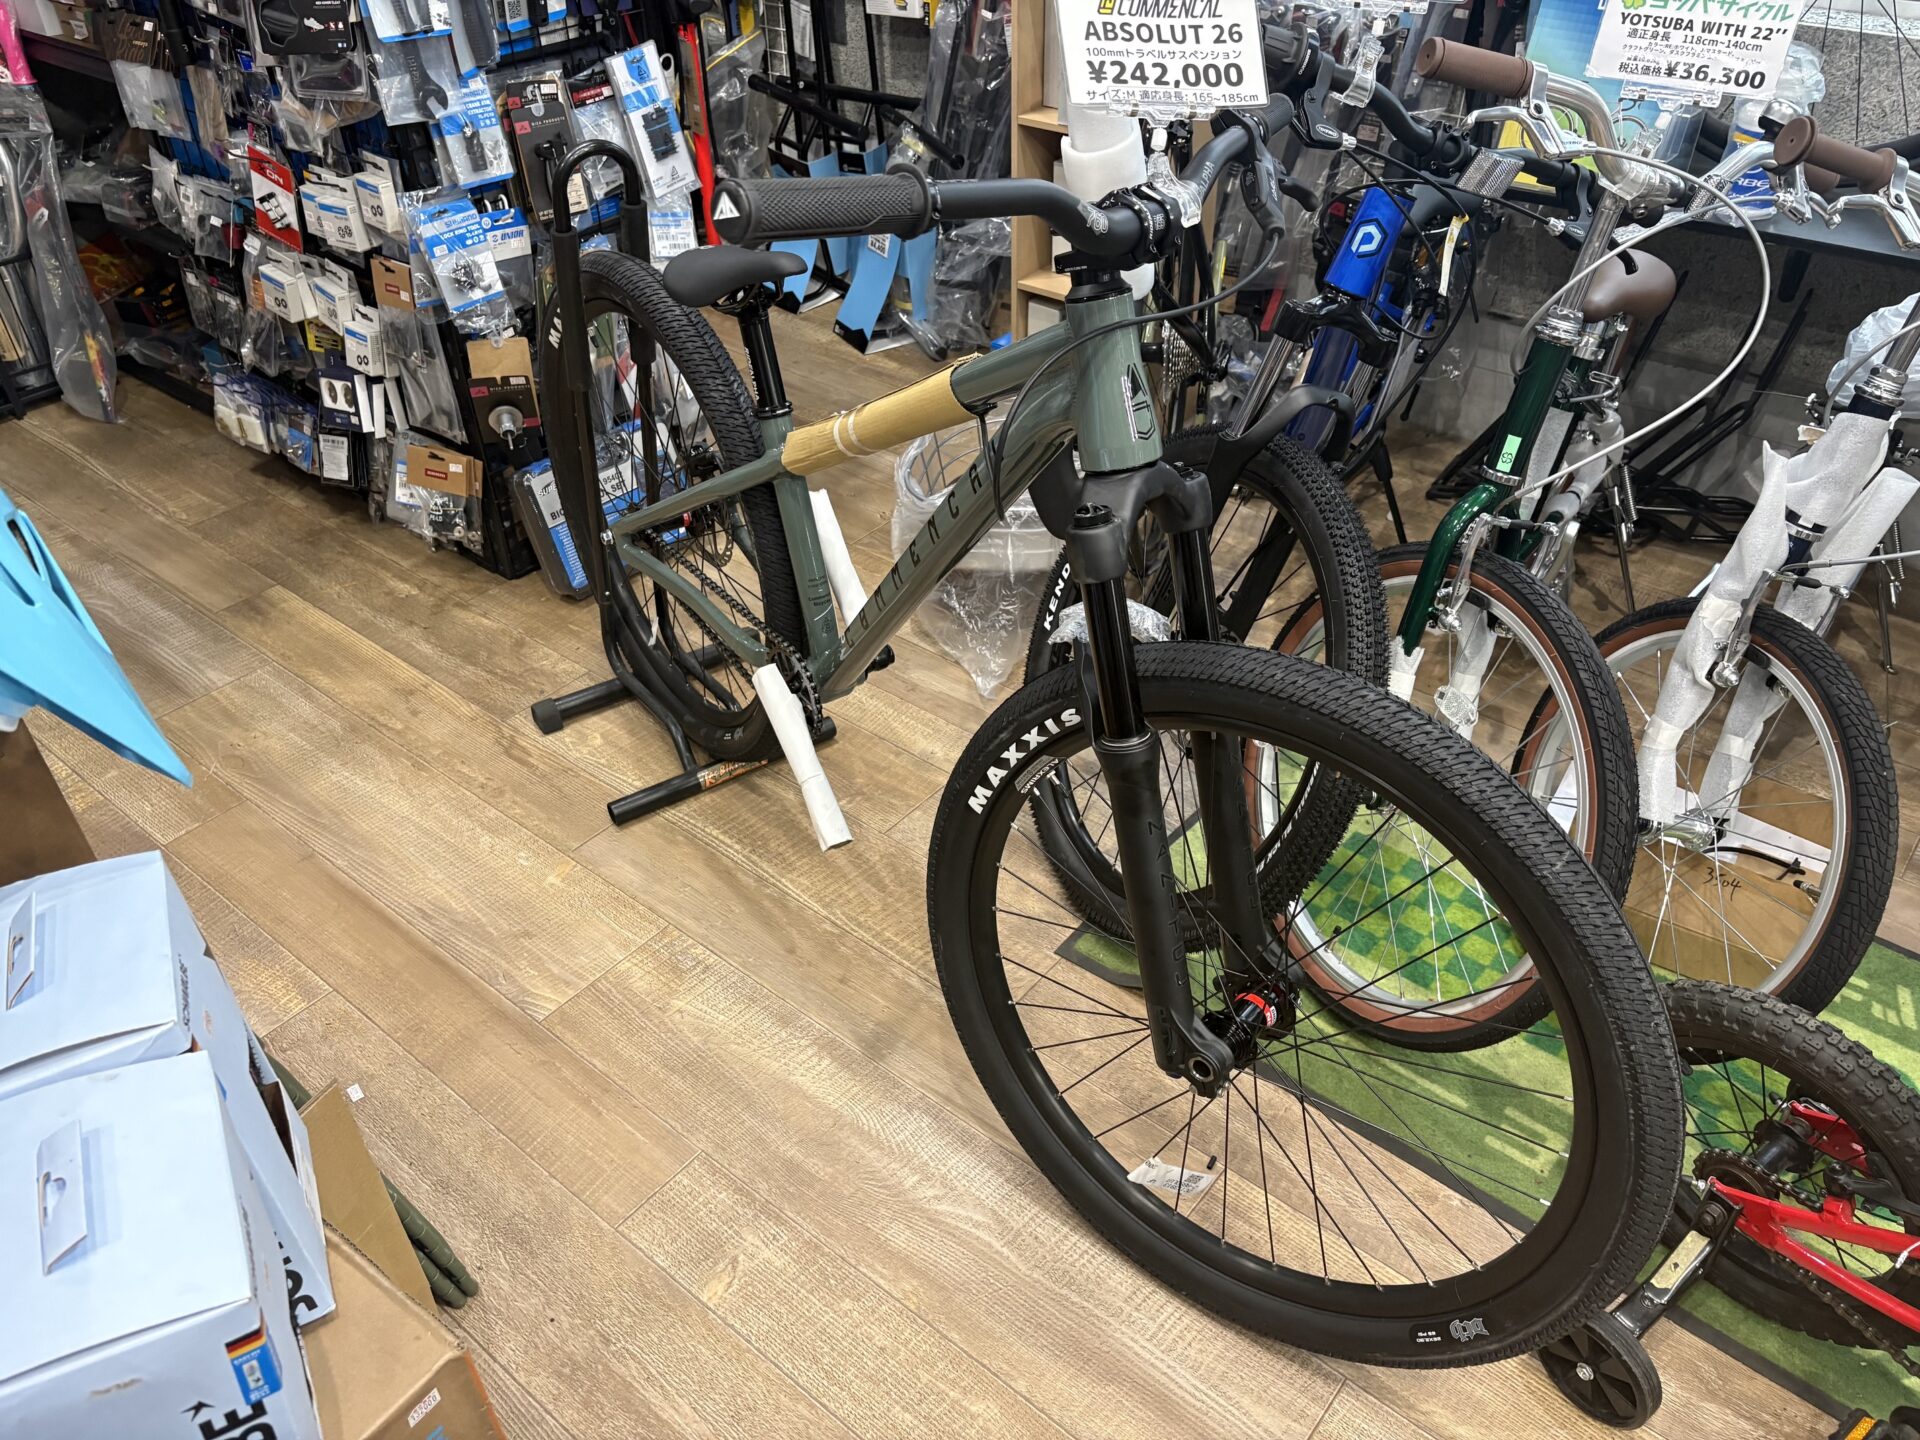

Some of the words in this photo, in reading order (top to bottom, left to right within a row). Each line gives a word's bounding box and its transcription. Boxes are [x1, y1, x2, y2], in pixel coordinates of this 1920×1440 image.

[1084, 20, 1204, 44] ABSOLUT
[1211, 23, 1243, 44] 26
[1620, 12, 1694, 32] YOTSUBA
[1700, 20, 1747, 38] WITH
[1626, 27, 1671, 43] 適正身長
[1682, 34, 1763, 53] 118cm~140cm
[1085, 47, 1243, 60] 100mmトラベルサスペンション
[1086, 60, 1244, 88] ¥242,000
[1618, 61, 1662, 78] 税込価格
[1663, 60, 1766, 90] ¥36,300
[1192, 92, 1259, 103] 165~185cm
[467, 223, 481, 232] TOOL
[538, 483, 558, 497] SUPE
[1043, 563, 1071, 631] KEND
[967, 708, 1082, 815] MAXXIS
